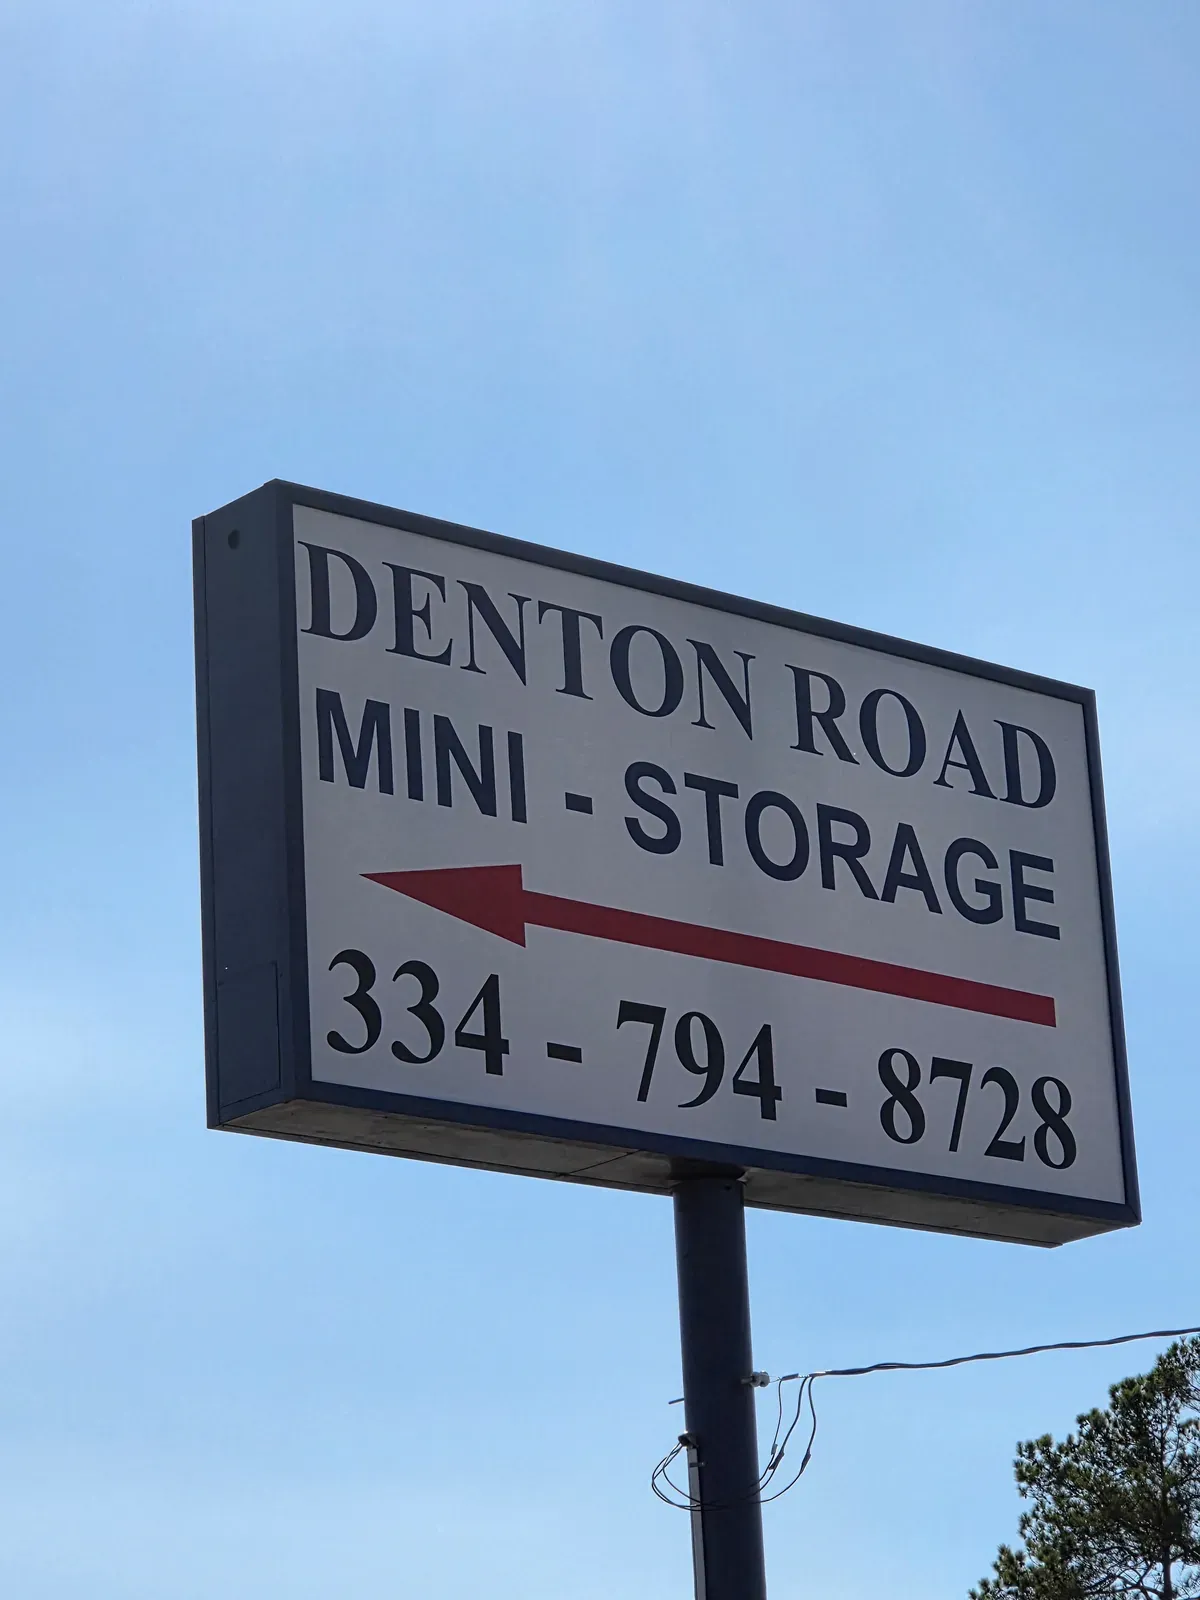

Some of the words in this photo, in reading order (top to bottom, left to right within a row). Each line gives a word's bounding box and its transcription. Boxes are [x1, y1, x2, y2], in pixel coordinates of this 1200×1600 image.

[297, 541, 756, 741] DENTON
[785, 664, 1057, 809] ROAD
[316, 687, 527, 824] MINI
[624, 761, 1061, 940] STORAGE
[326, 948, 510, 1076] 334
[616, 1000, 782, 1121] 794
[878, 1047, 1077, 1170] 8728
